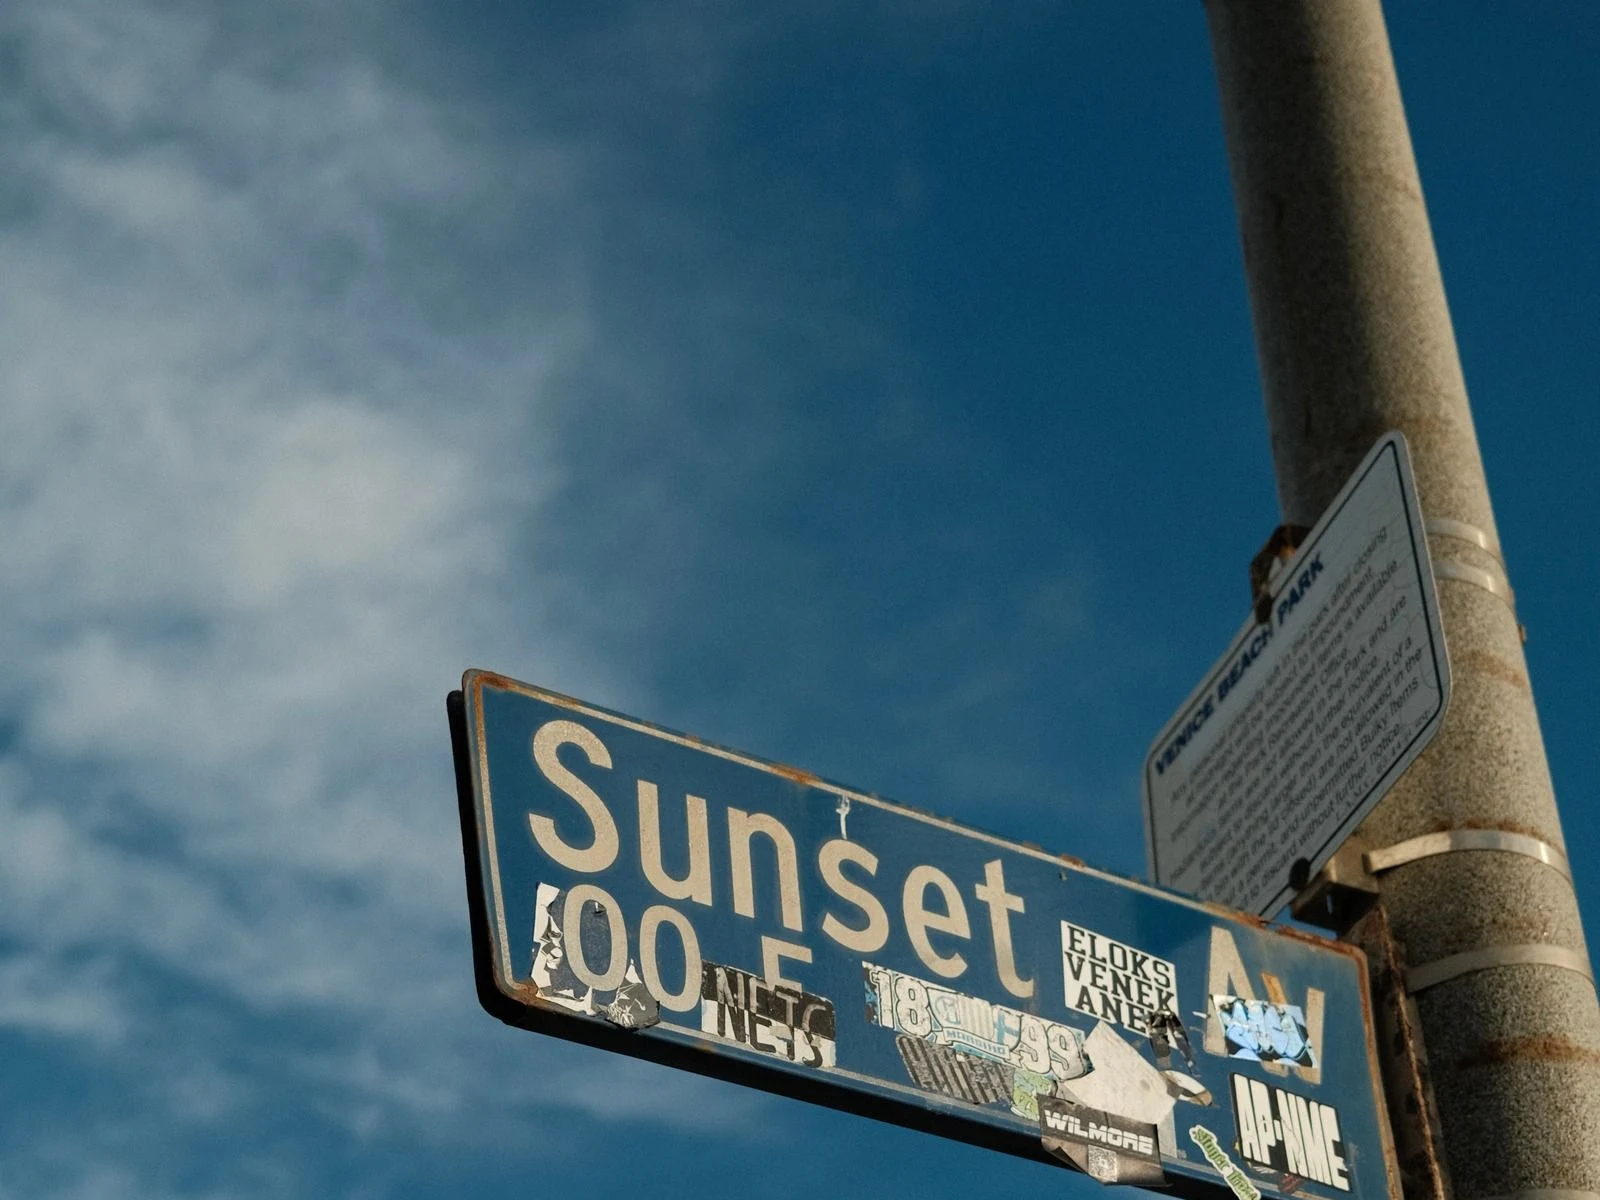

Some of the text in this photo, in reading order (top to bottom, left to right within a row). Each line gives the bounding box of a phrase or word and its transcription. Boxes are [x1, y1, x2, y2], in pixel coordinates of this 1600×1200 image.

[1291, 627, 1307, 657] the
[1330, 570, 1351, 607] after
[1352, 523, 1388, 580] closing
[1354, 556, 1397, 621] available
[1156, 550, 1324, 782] VENICE BEACH PARK
[1326, 672, 1342, 702] the
[1343, 642, 1366, 679] Park
[1367, 615, 1388, 651] and
[1389, 593, 1406, 622] are
[1318, 752, 1334, 780] are
[1335, 728, 1353, 759] not
[1354, 681, 1392, 737] allowed
[1404, 643, 1422, 675] the
[1322, 722, 1339, 752] the
[1340, 659, 1391, 732] equivalent
[1359, 711, 1387, 757] Bulky
[1335, 759, 1367, 807] further
[529, 719, 1035, 1000] Sunset
[1064, 951, 1175, 1012] VENEK
[1067, 925, 1171, 988] ELOKS
[1044, 1109, 1153, 1155] WILMORE
